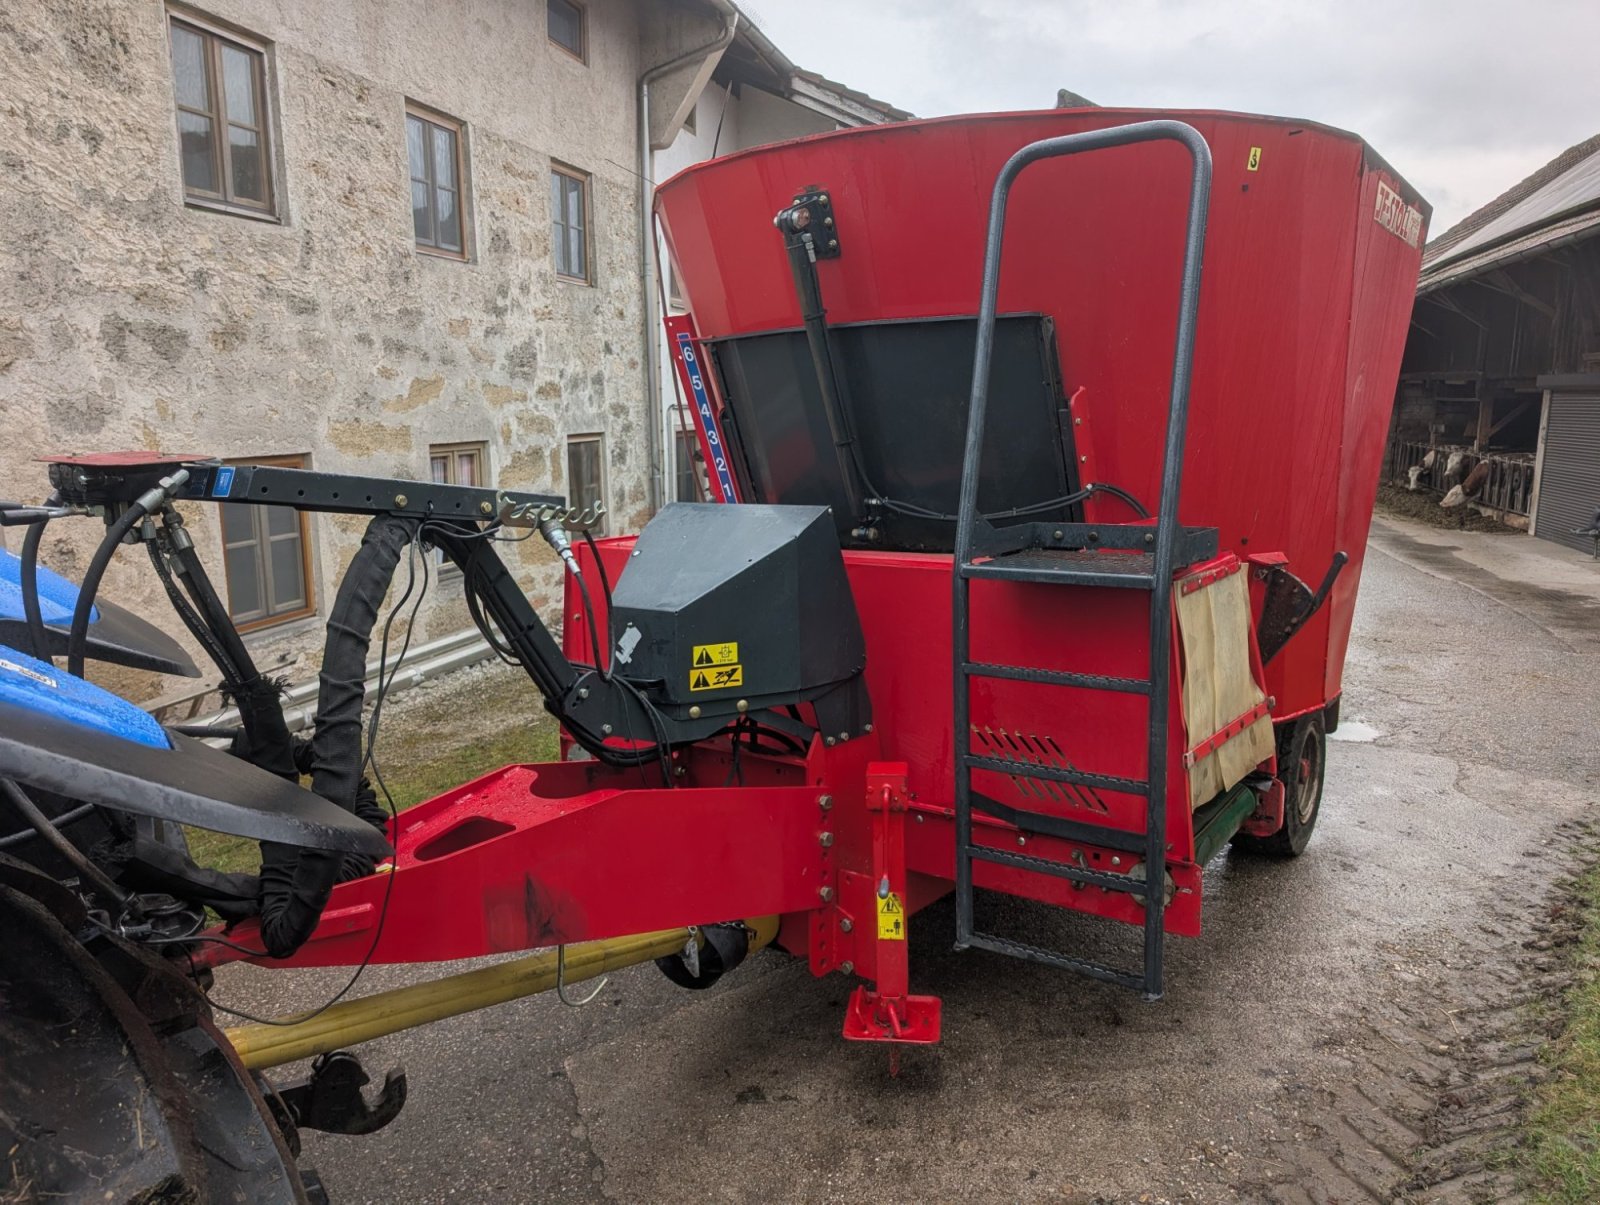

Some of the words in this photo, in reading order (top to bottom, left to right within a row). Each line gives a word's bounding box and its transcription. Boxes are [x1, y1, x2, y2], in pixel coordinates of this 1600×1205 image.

[683, 346, 694, 361] 6
[692, 375, 702, 390] 5
[700, 403, 710, 417] 4
[708, 430, 718, 445] 3
[716, 457, 726, 471] 2
[723, 483, 732, 497] 1
